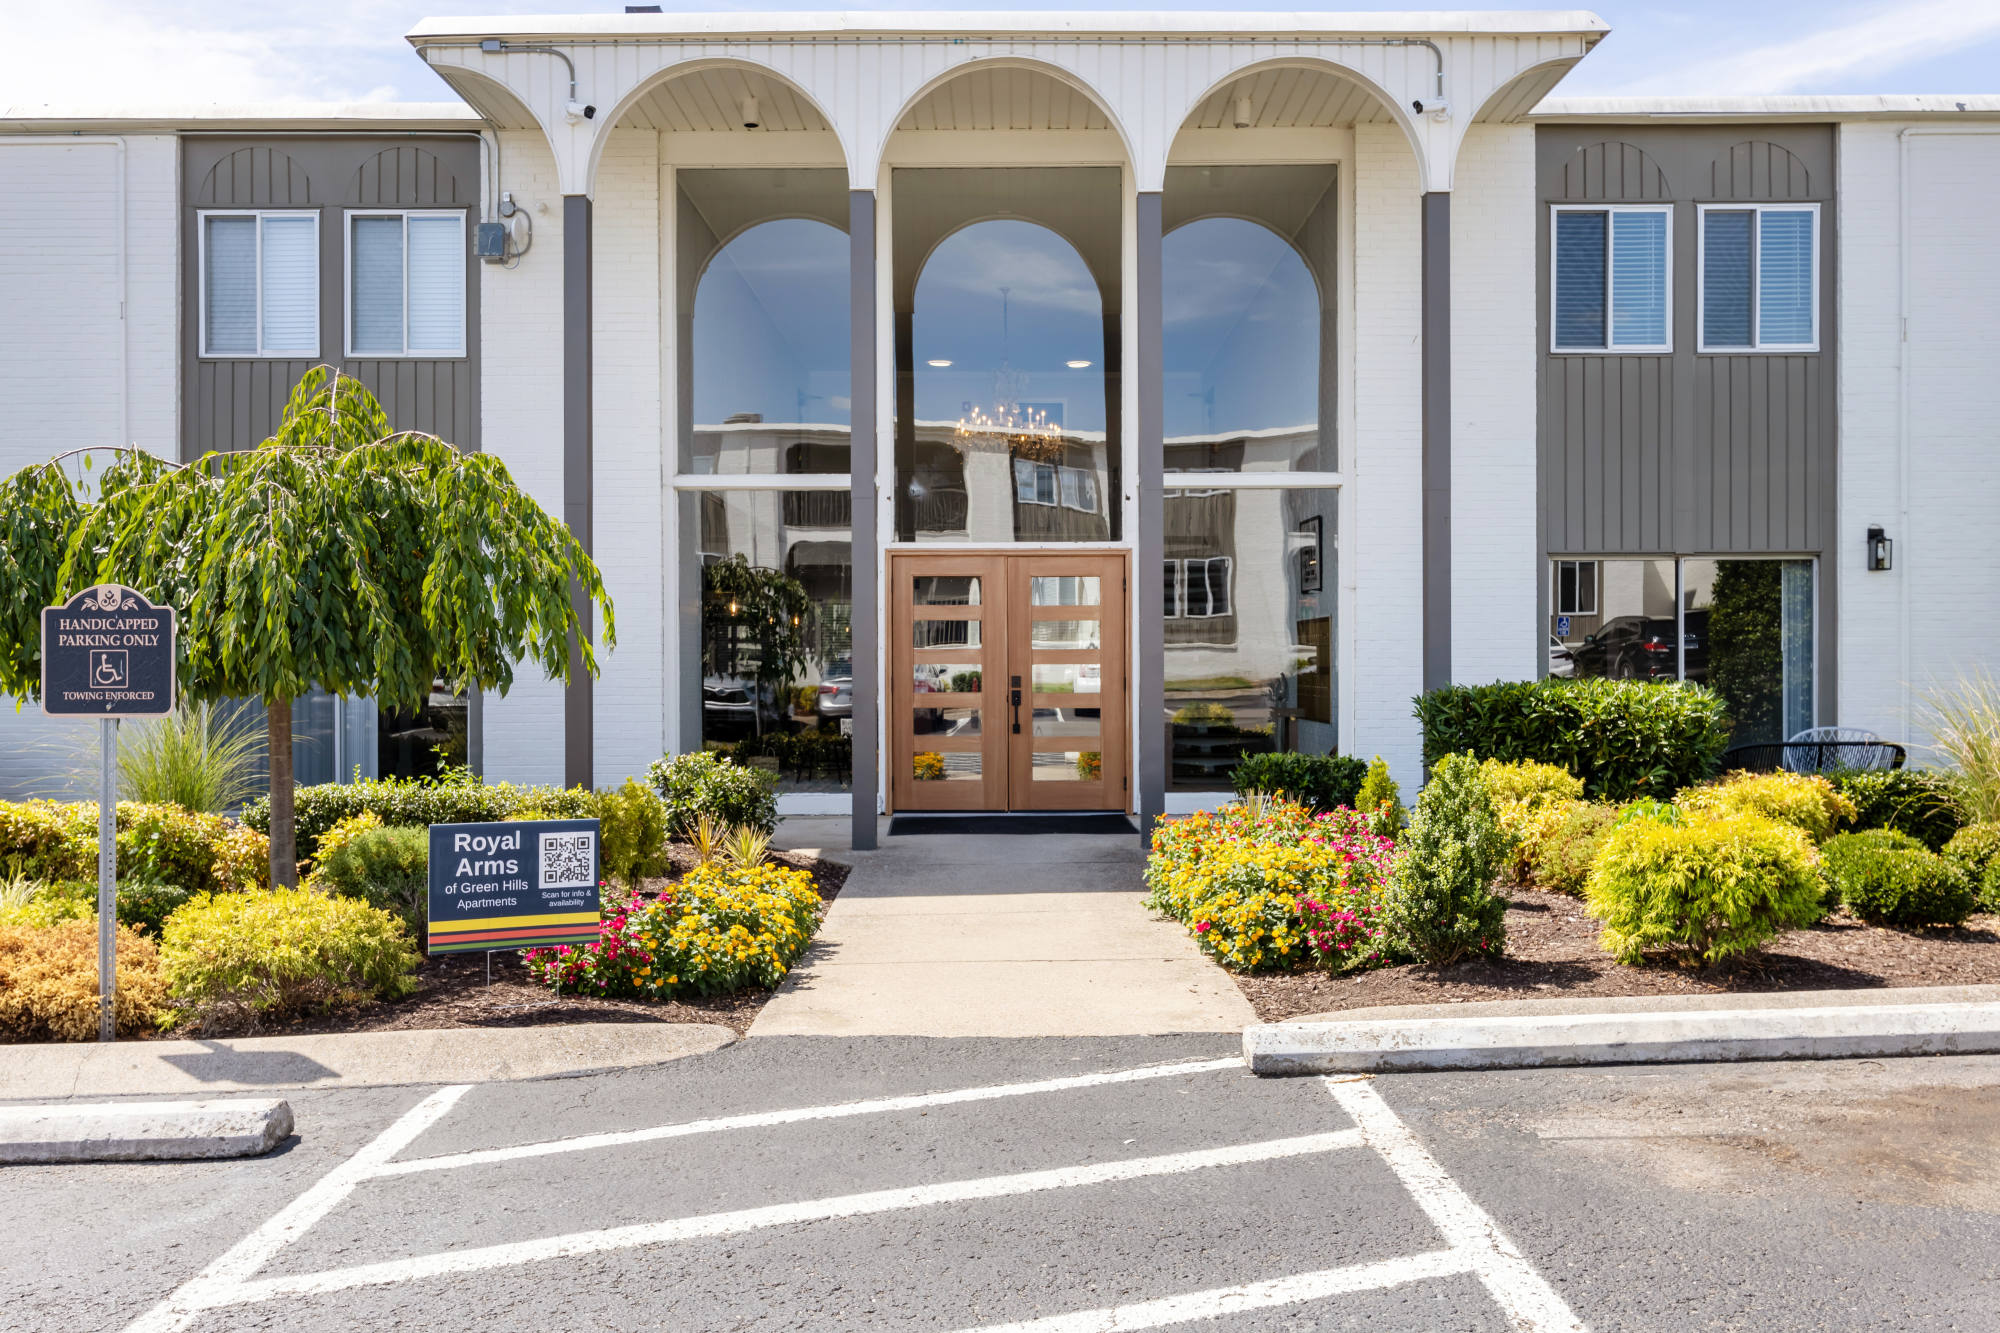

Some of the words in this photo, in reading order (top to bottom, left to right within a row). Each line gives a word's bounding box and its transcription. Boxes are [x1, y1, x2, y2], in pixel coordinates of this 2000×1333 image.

[60, 619, 159, 630] HANDICAPPED
[59, 634, 120, 646] PARKING
[123, 634, 160, 646] ONLY
[63, 692, 103, 700] TOWING
[106, 692, 154, 700] ENFORCED
[454, 830, 521, 856] Royal
[455, 857, 519, 877] Arms
[445, 883, 458, 895] of
[460, 882, 499, 894] Green
[502, 879, 529, 892] Hills
[542, 892, 560, 900] Scan
[561, 890, 570, 898] for
[572, 890, 584, 898] info
[586, 890, 592, 898] &
[457, 896, 517, 911] Apartments
[549, 900, 585, 908] availability
